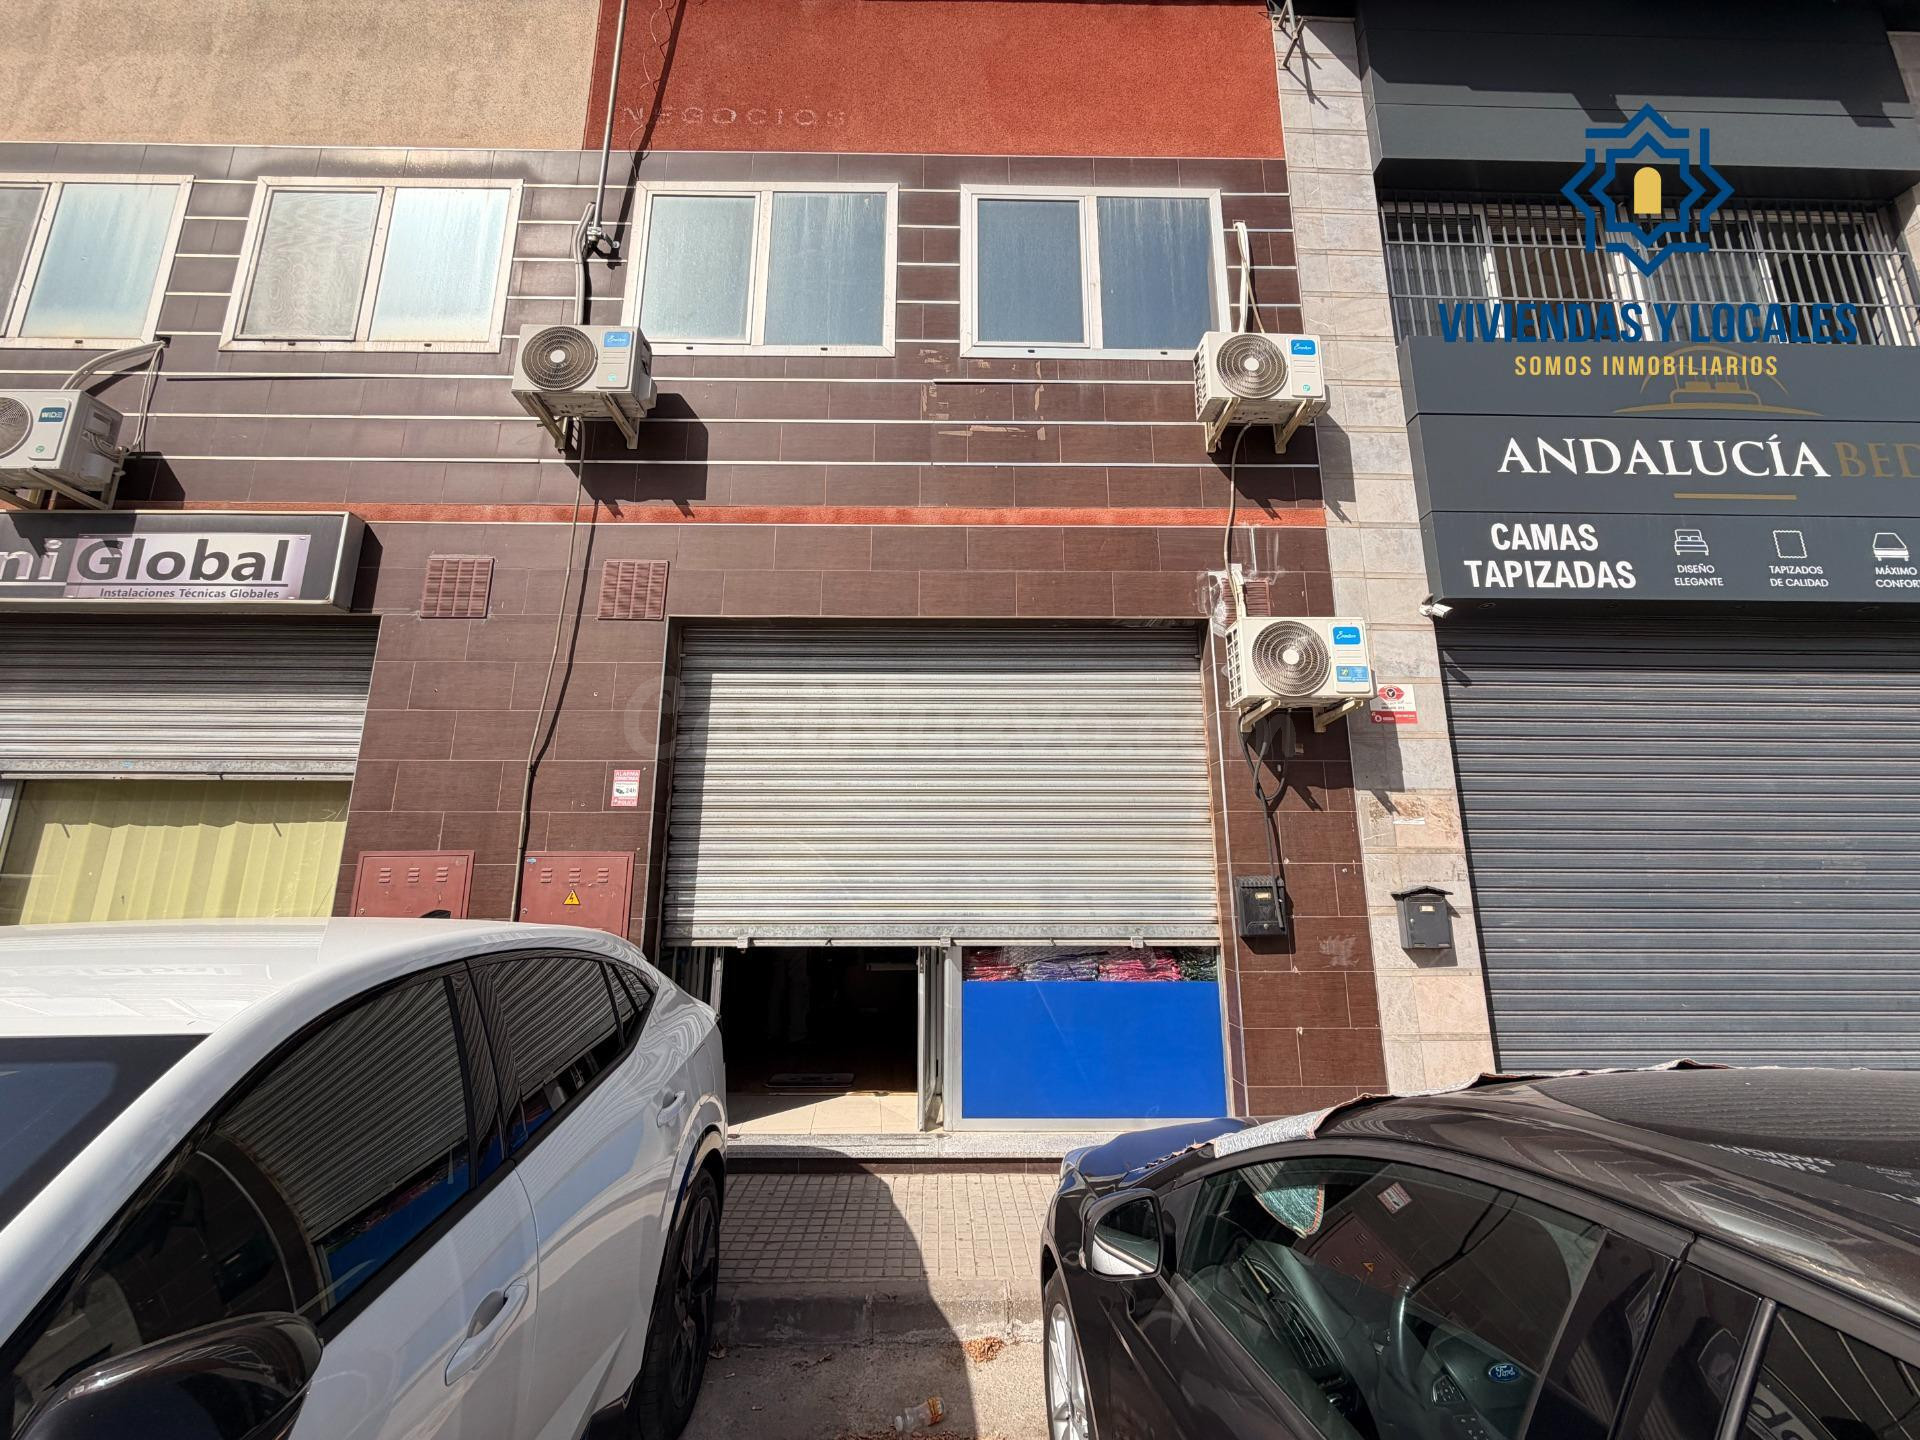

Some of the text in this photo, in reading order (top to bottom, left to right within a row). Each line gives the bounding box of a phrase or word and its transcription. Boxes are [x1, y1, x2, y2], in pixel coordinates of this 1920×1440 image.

[1497, 433, 1832, 477] ANDALUCÍA
[1490, 522, 1599, 551] CAMAS
[77, 538, 290, 582] Global
[1677, 563, 1715, 574] DISEÑO
[1769, 565, 1824, 575] TAPIZADOS
[1875, 564, 1918, 576] MÁXIMO
[1463, 560, 1637, 589] TAPIZADAS
[1674, 577, 1724, 587] ELEGANTE
[1769, 578, 1829, 588] DE CALIDAD
[1875, 579, 1920, 588] CONFOR
[100, 588, 280, 599] Instalaciones Técnicas Globales
[1495, 1364, 1516, 1378] Ford
